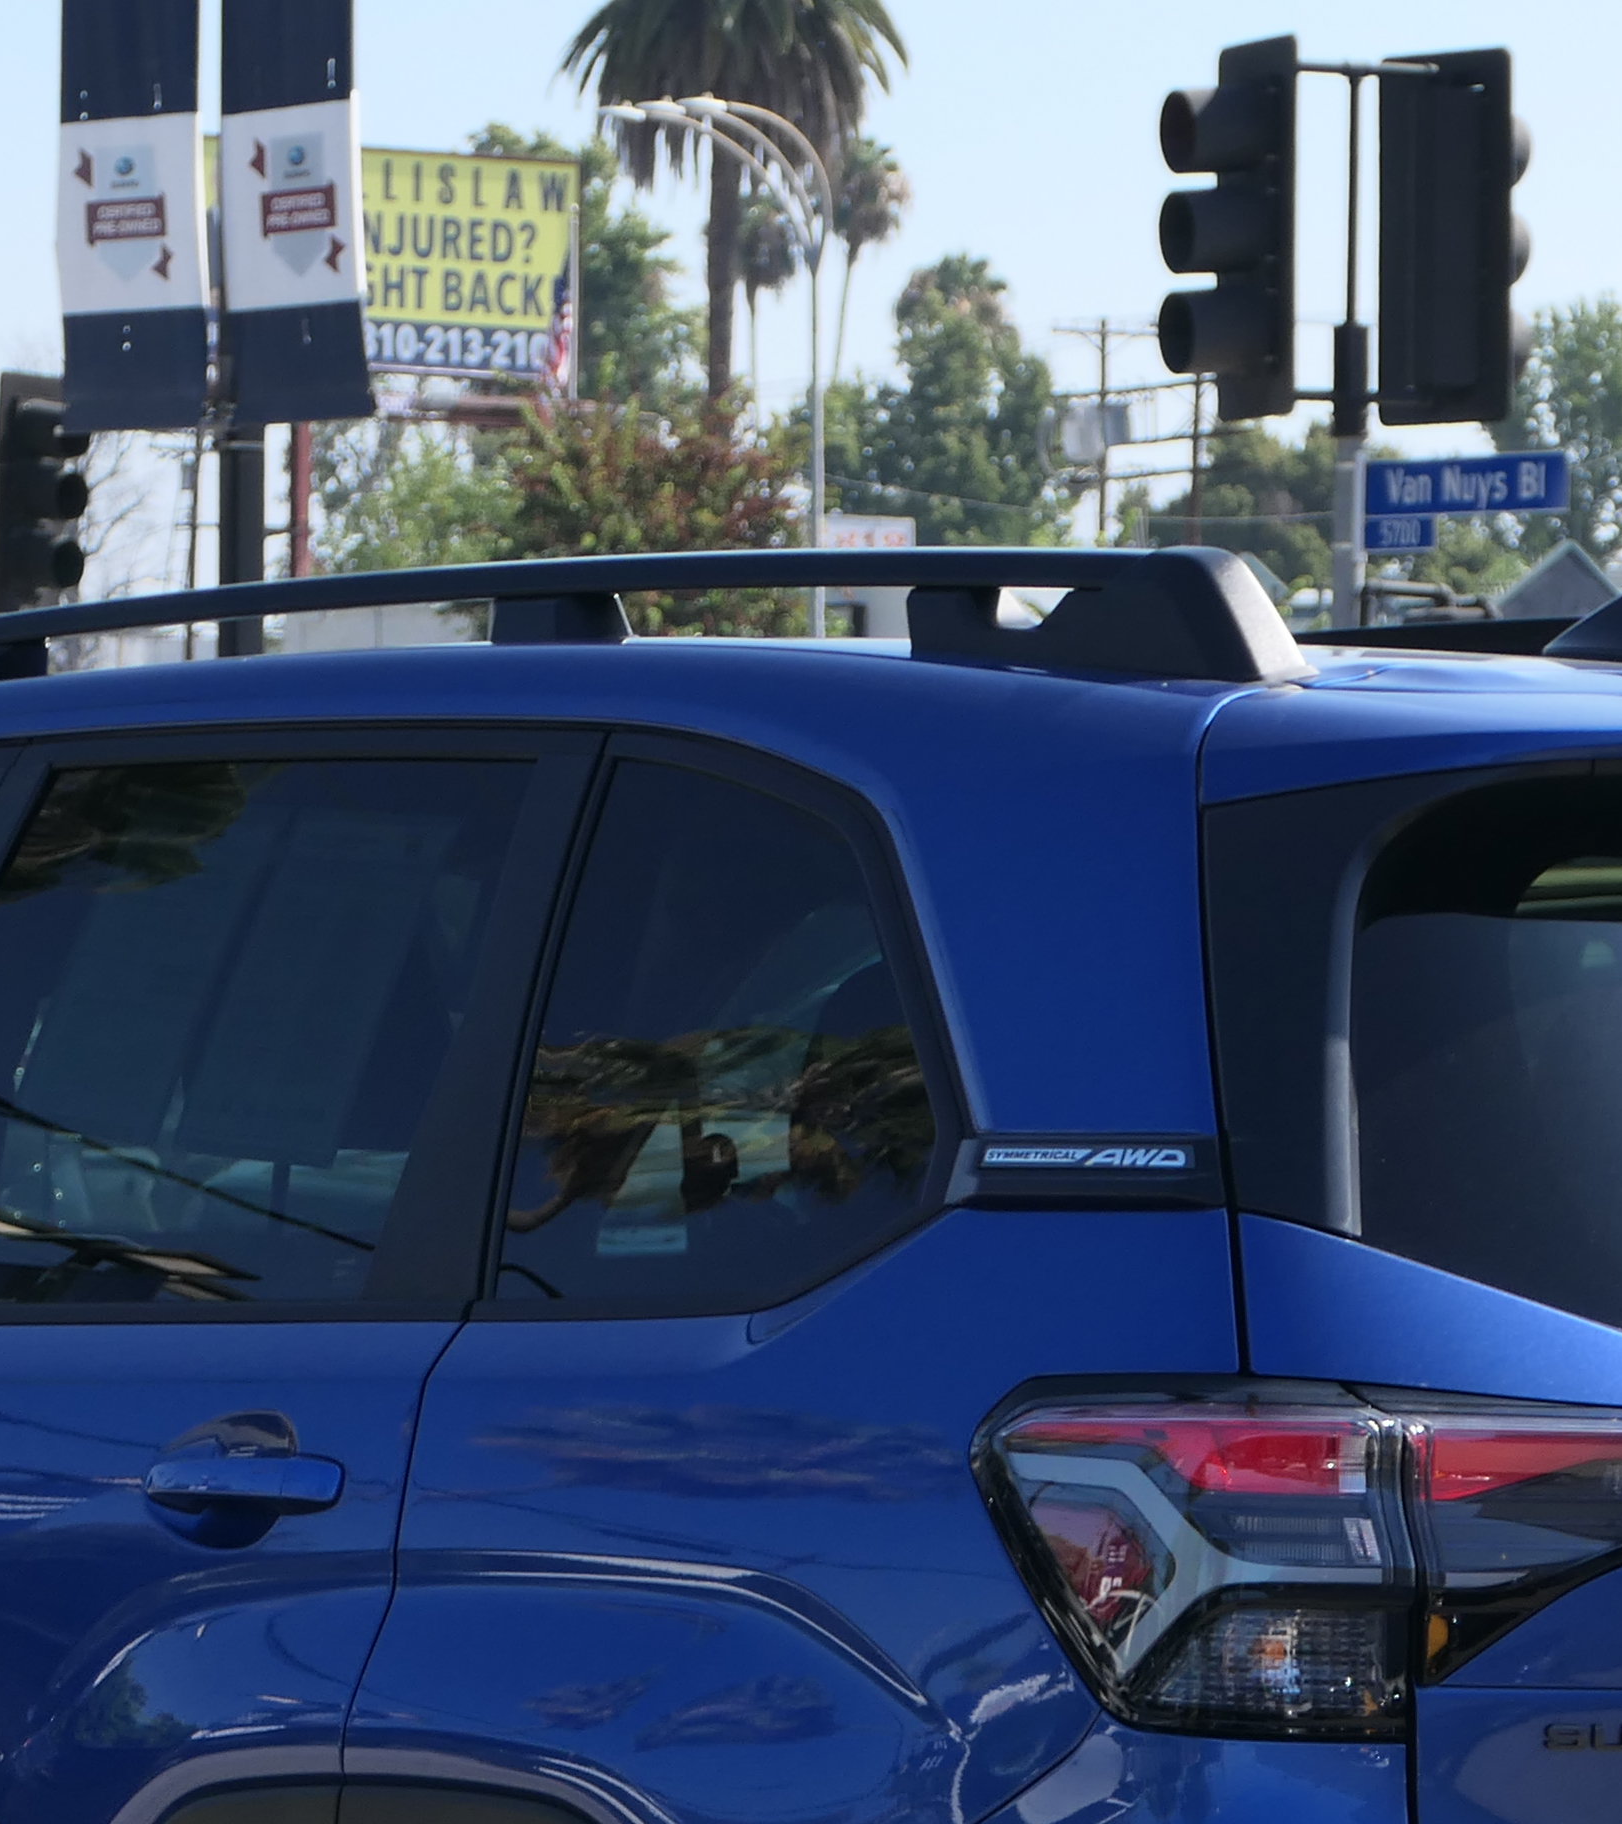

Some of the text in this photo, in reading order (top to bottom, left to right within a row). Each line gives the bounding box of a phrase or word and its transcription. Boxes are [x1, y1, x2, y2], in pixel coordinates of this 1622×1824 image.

[363, 210, 536, 264] NJURED?
[366, 322, 553, 370] 310-213-210
[1386, 460, 1547, 509] Van Nuys Bl
[1381, 519, 1422, 546] 5700
[987, 1149, 1186, 1166] SYMMETRICAL AWD
